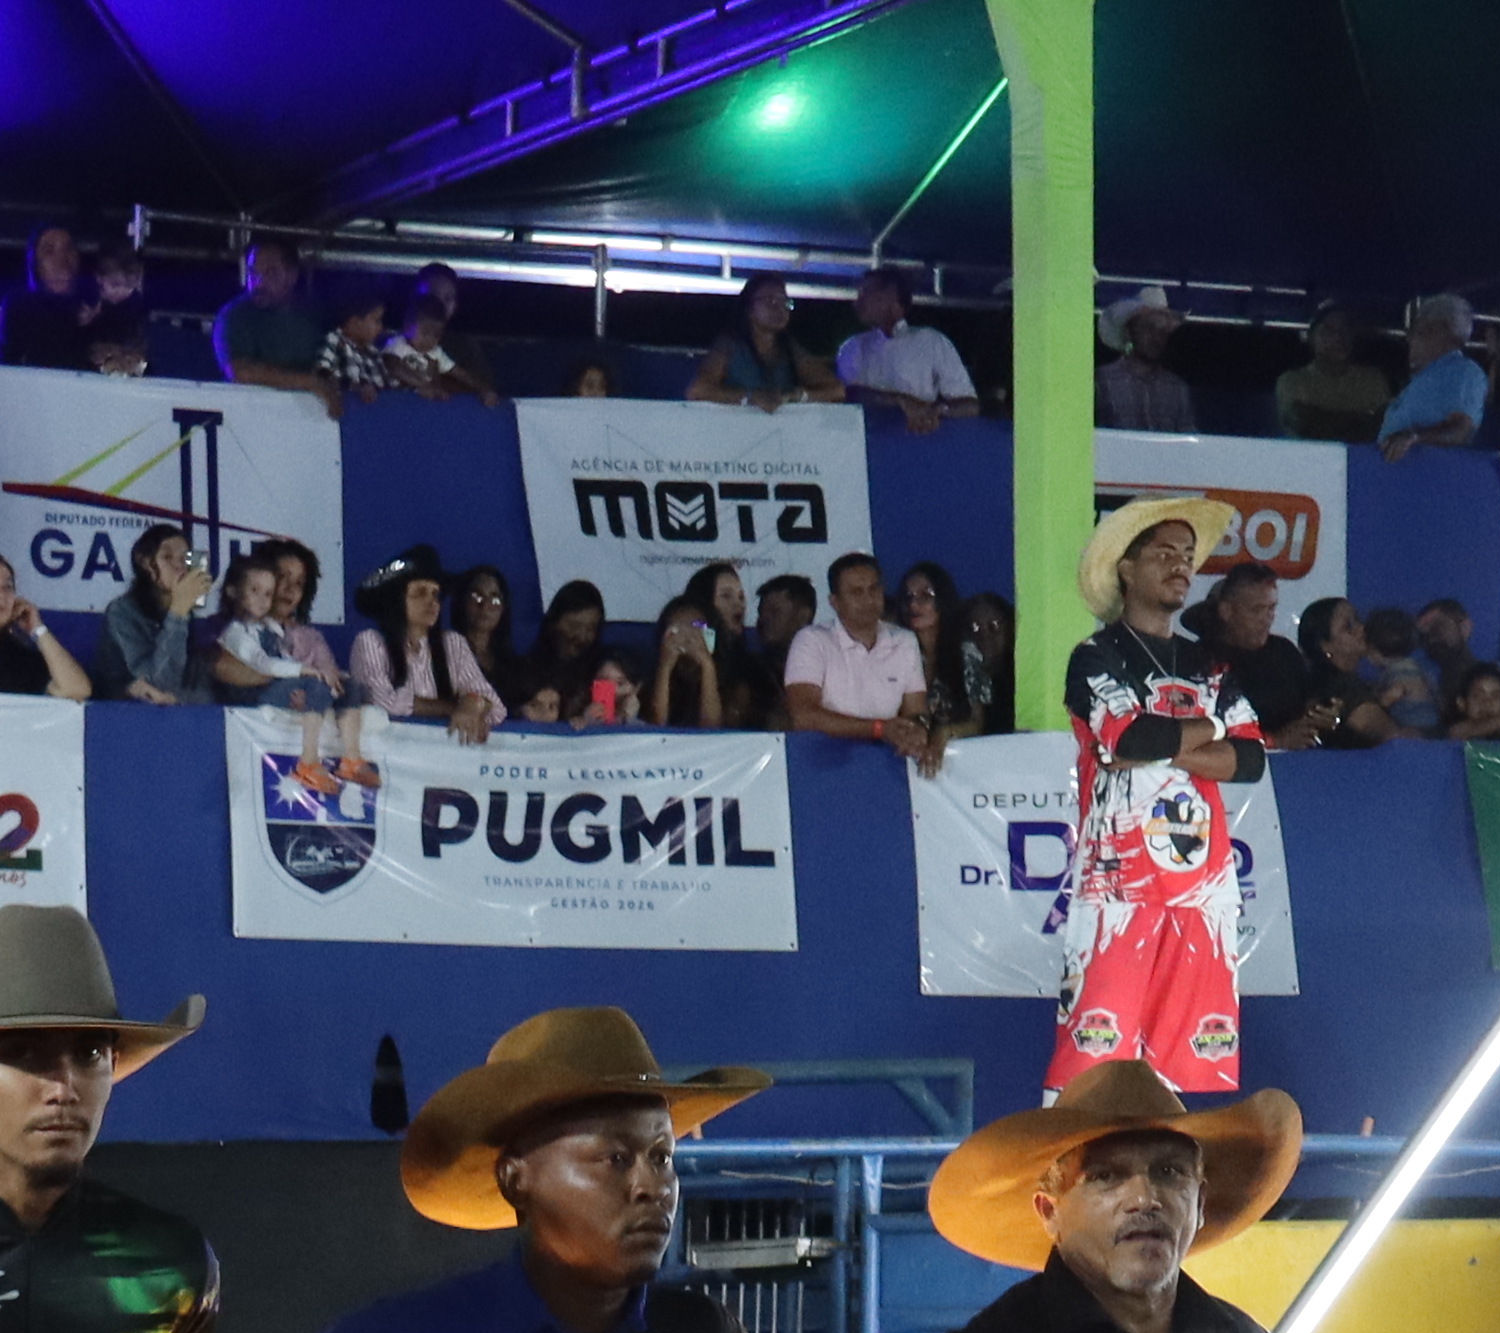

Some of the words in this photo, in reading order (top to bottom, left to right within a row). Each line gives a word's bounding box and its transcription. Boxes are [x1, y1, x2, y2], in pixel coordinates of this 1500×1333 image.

[570, 457, 638, 473] AGÊNCIA
[644, 460, 664, 473] DE
[670, 460, 758, 475] MARKETING
[763, 462, 821, 475] DIGITAL
[45, 512, 105, 526] DEPUTADO
[479, 764, 549, 781] PODER
[567, 767, 705, 782] LEGISLATIVO
[972, 792, 1079, 809] DEPUTA
[420, 786, 777, 868] PUGMIL
